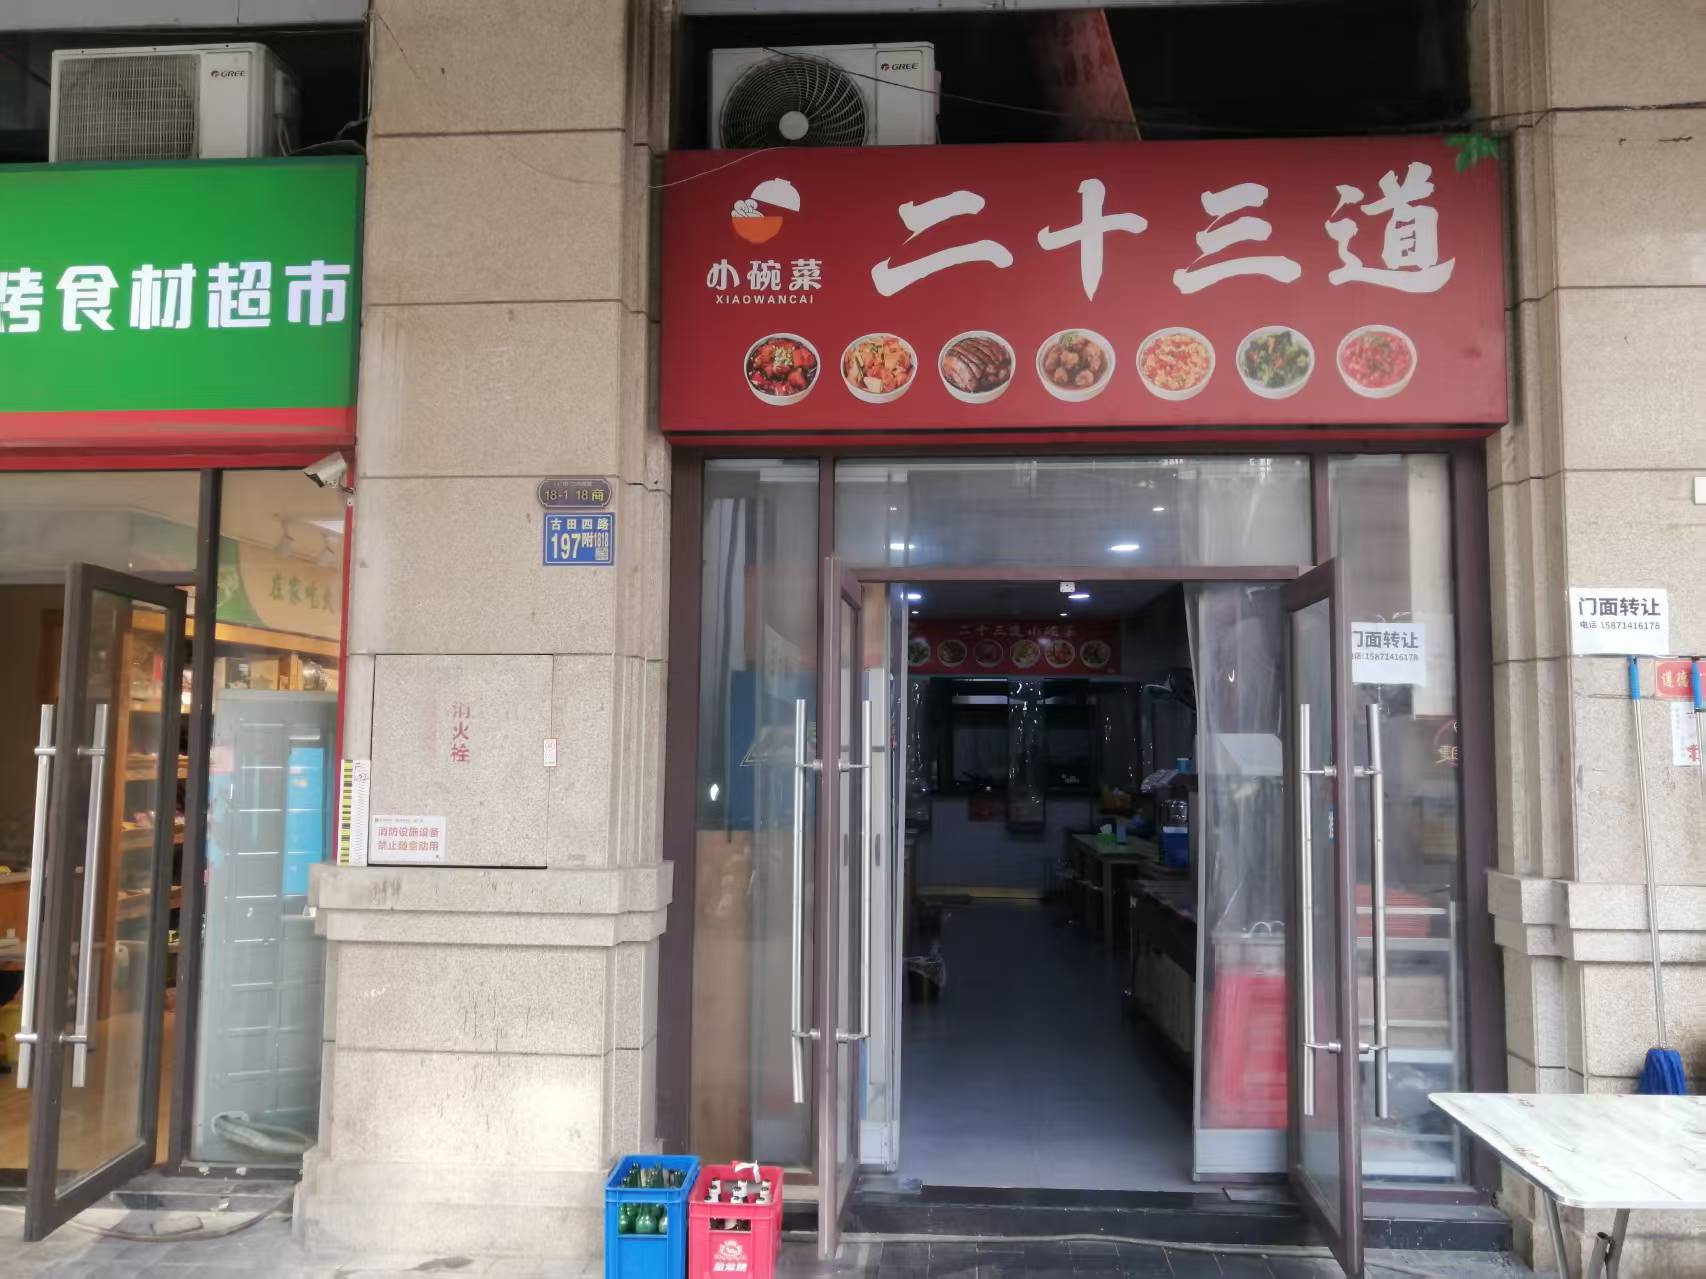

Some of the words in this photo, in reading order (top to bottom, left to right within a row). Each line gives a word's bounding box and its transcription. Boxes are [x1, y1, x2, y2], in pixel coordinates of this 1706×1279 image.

[871, 162, 1456, 301] 二十三道
[706, 258, 823, 291] 小碗菜
[0, 260, 351, 333] 烤食材超市
[715, 294, 814, 305] XIAOWANCAI
[551, 518, 609, 531] 古田四路
[1578, 596, 1662, 617] 门面转让
[450, 702, 471, 764] 消火栓
